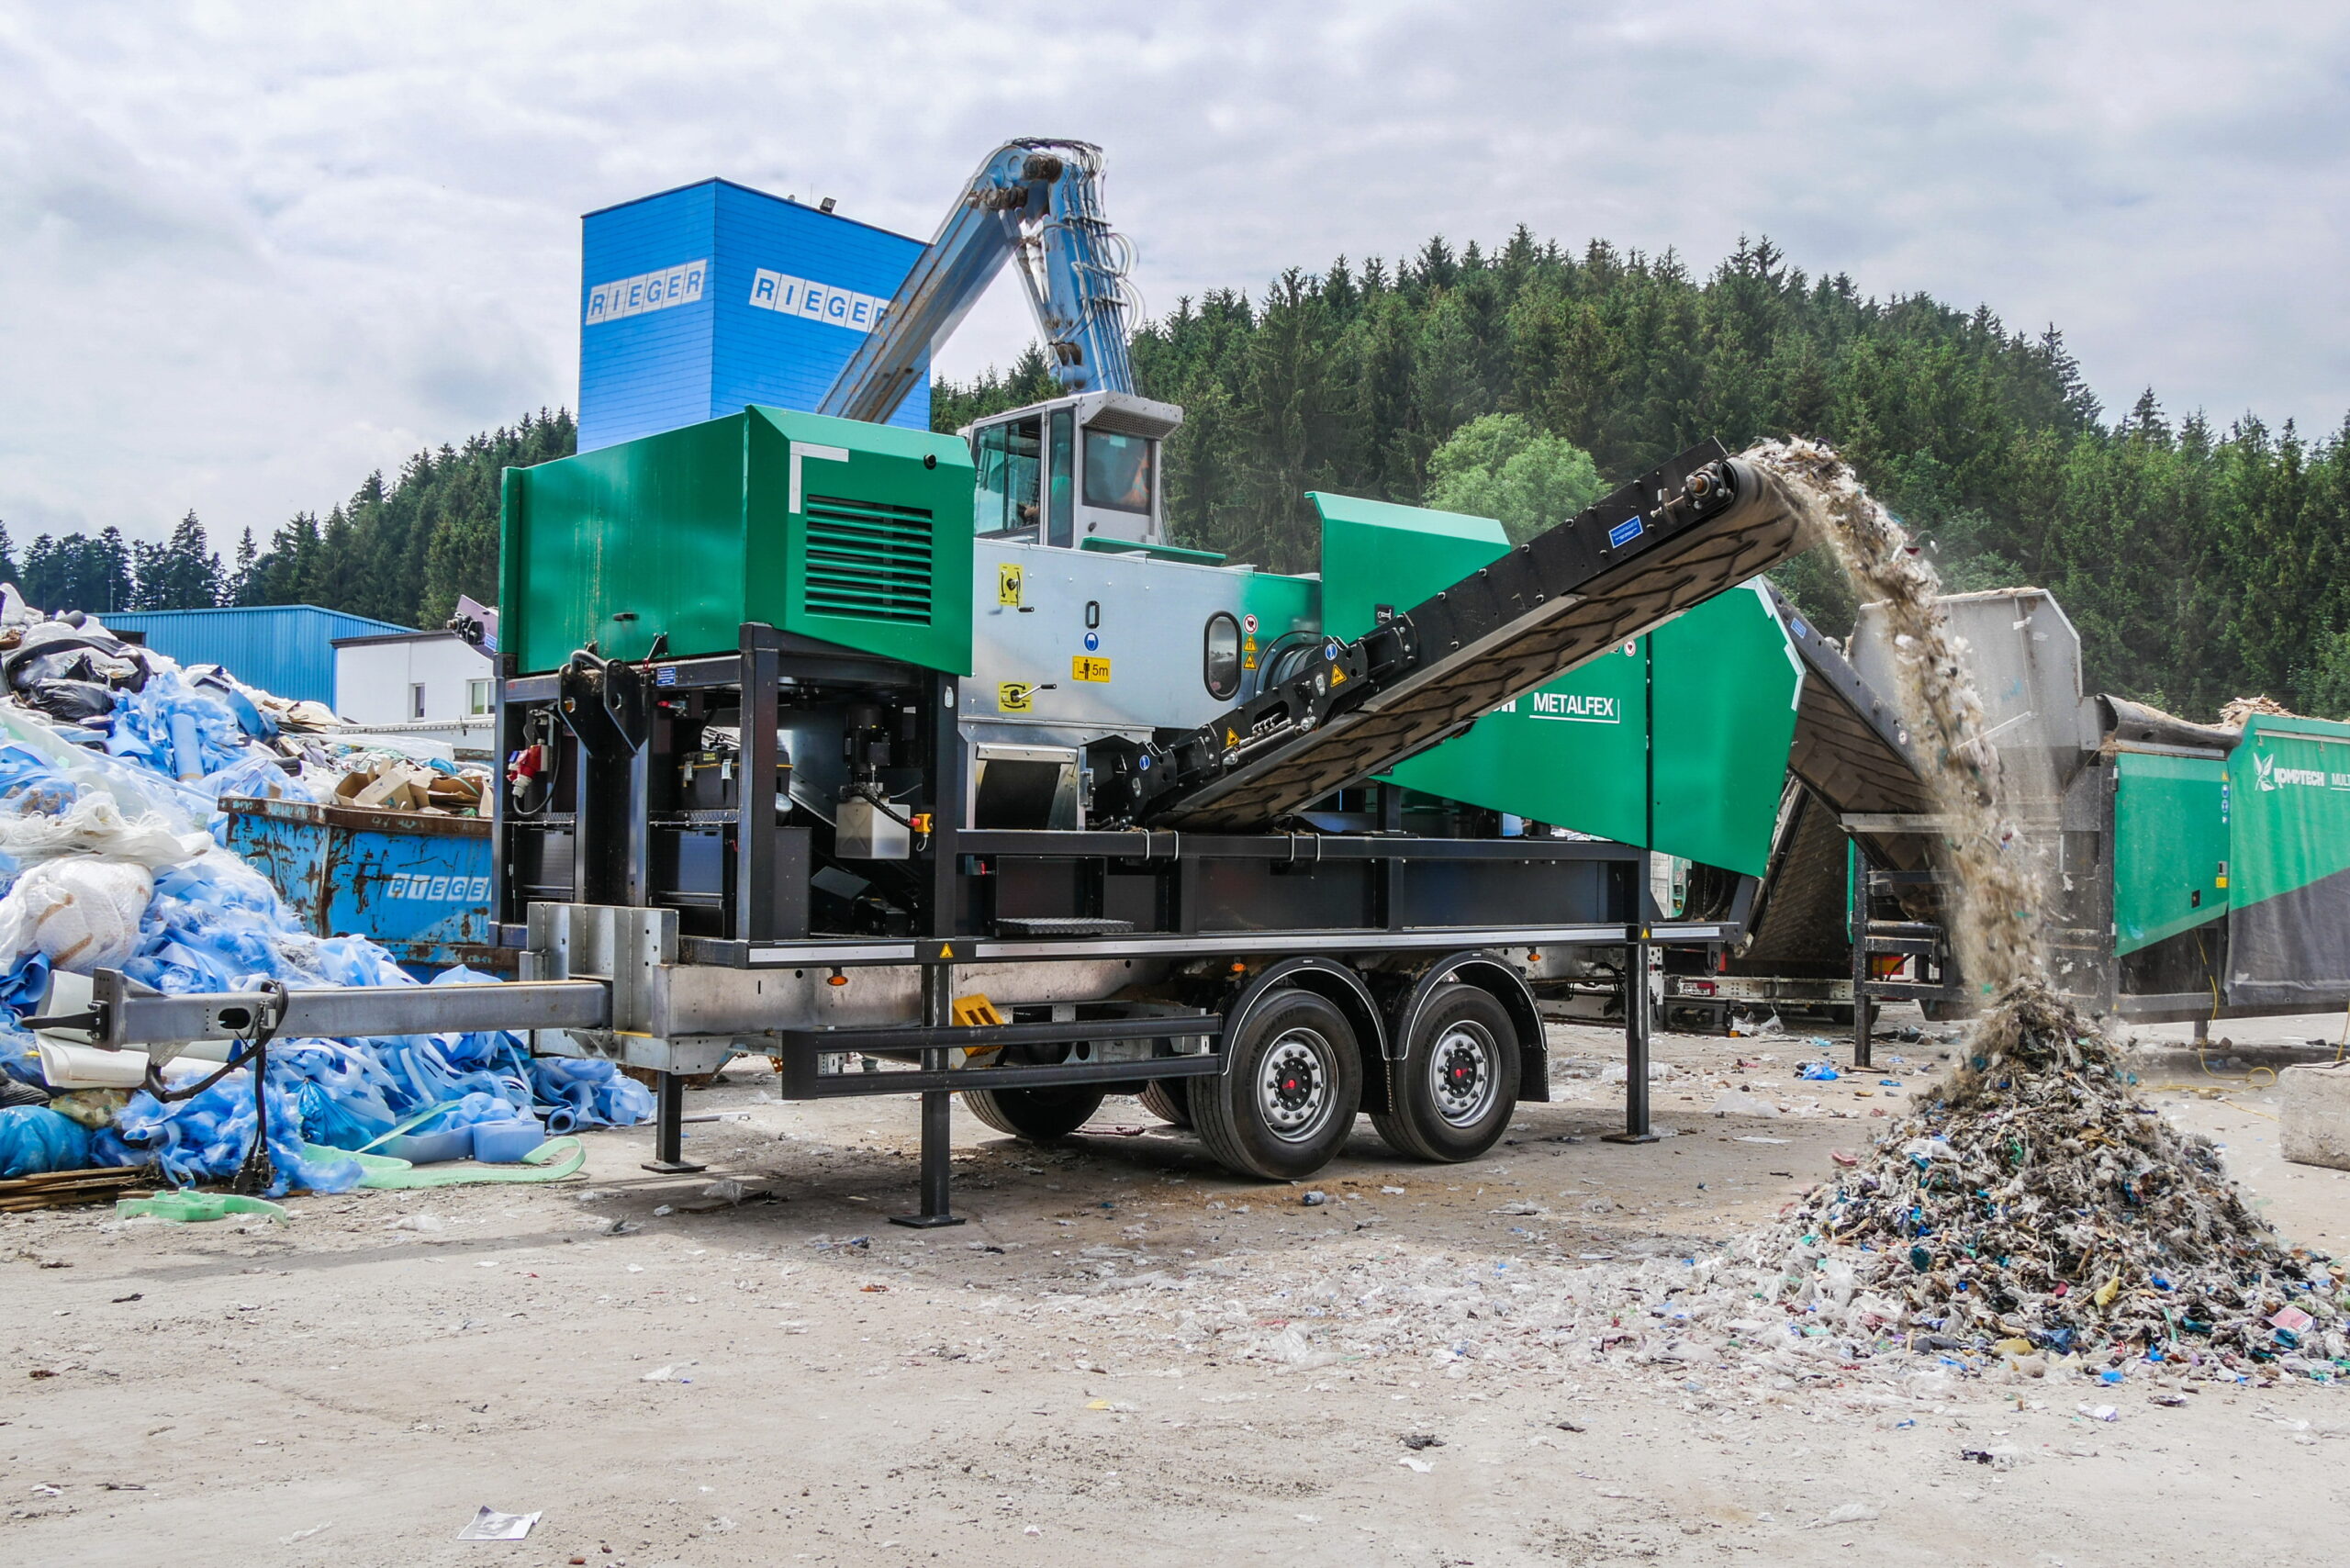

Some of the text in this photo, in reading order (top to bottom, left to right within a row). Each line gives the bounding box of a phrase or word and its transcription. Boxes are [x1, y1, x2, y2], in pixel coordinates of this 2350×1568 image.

[590, 270, 701, 317] RIEGER
[1092, 664, 1109, 678] 5m
[1534, 692, 1615, 717] METALFEX
[2274, 767, 2325, 789] KOMPTECH
[391, 877, 490, 898] RIEGE
[1253, 1021, 1277, 1053] Hybrid
